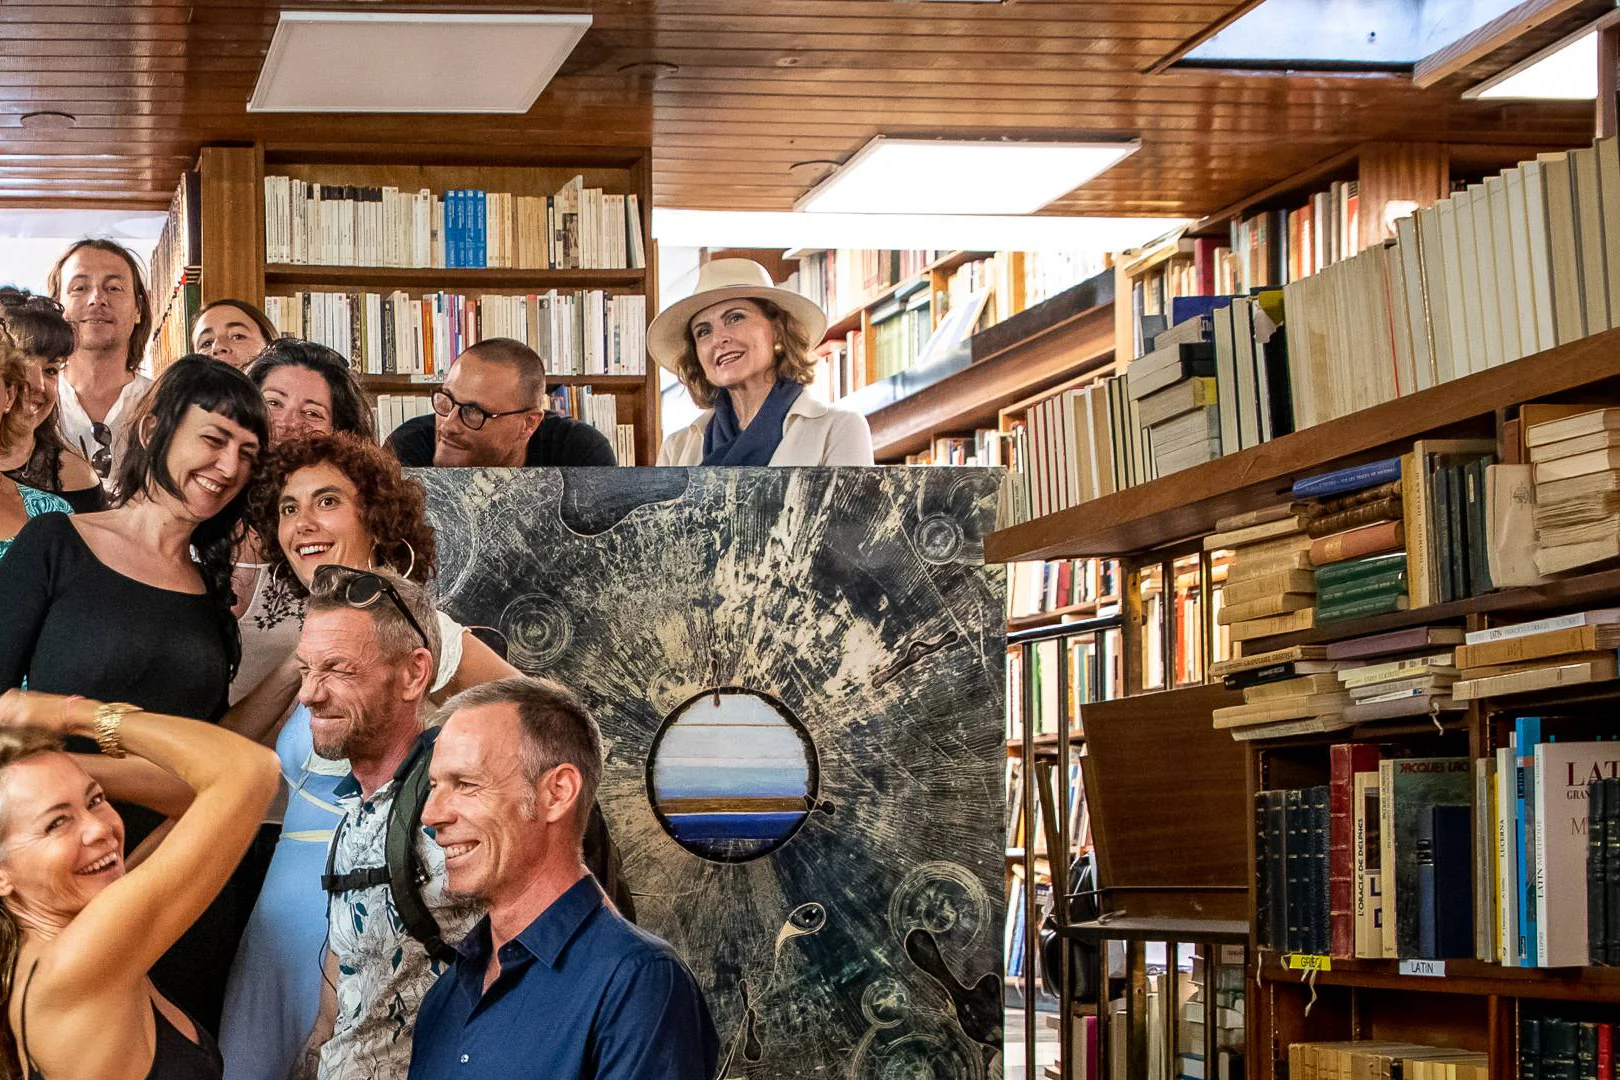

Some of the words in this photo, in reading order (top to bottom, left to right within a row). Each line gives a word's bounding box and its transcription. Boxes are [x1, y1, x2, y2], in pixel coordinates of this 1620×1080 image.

[1356, 817, 1364, 857] DELPHES
[1357, 858, 1364, 872] DE
[1357, 873, 1365, 917] L'ORACLE
[1536, 867, 1544, 899] LATIN
[1411, 961, 1434, 974] LATIN
